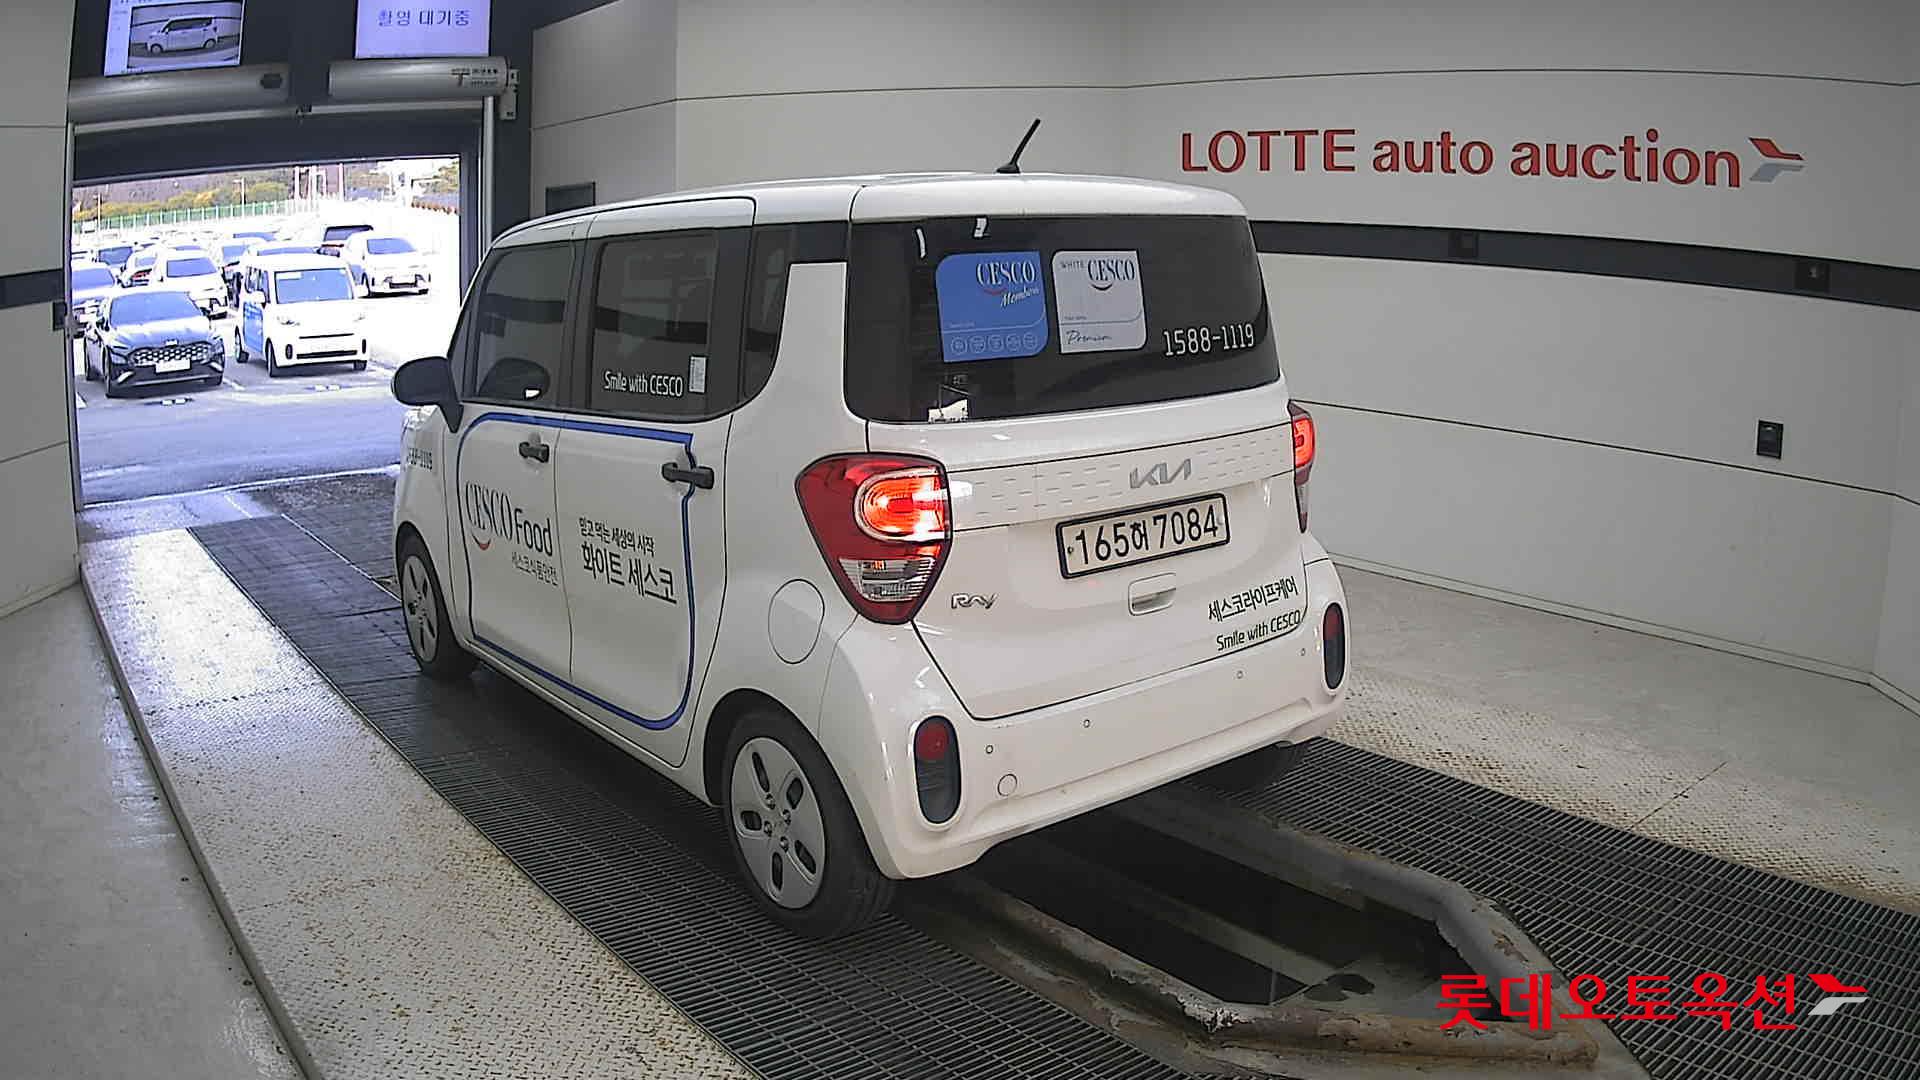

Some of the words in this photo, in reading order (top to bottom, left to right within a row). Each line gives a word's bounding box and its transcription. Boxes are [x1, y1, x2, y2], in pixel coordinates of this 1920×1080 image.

[419, 9, 471, 27] 대기중
[1181, 128, 1356, 173] LOTTE
[1371, 130, 1495, 175] auto
[1509, 128, 1741, 188] auction
[976, 260, 1036, 285] CESCO
[1060, 260, 1085, 270] WHITE
[1087, 259, 1136, 281] CESCO
[1163, 323, 1254, 356] 1588-1119
[604, 370, 627, 391] Smile
[628, 373, 648, 393] with
[649, 375, 684, 397] CESCO
[465, 481, 513, 540] CESCO
[514, 507, 553, 557] Food
[612, 527, 636, 552] 세상의
[638, 535, 655, 558] 시작
[581, 540, 625, 586] 화이트
[628, 558, 678, 604] 세스코
[1208, 575, 1298, 622] 세스코라이프케어
[1216, 630, 1245, 651] Smile
[1247, 621, 1269, 641] with
[1270, 609, 1301, 633] CESCO
